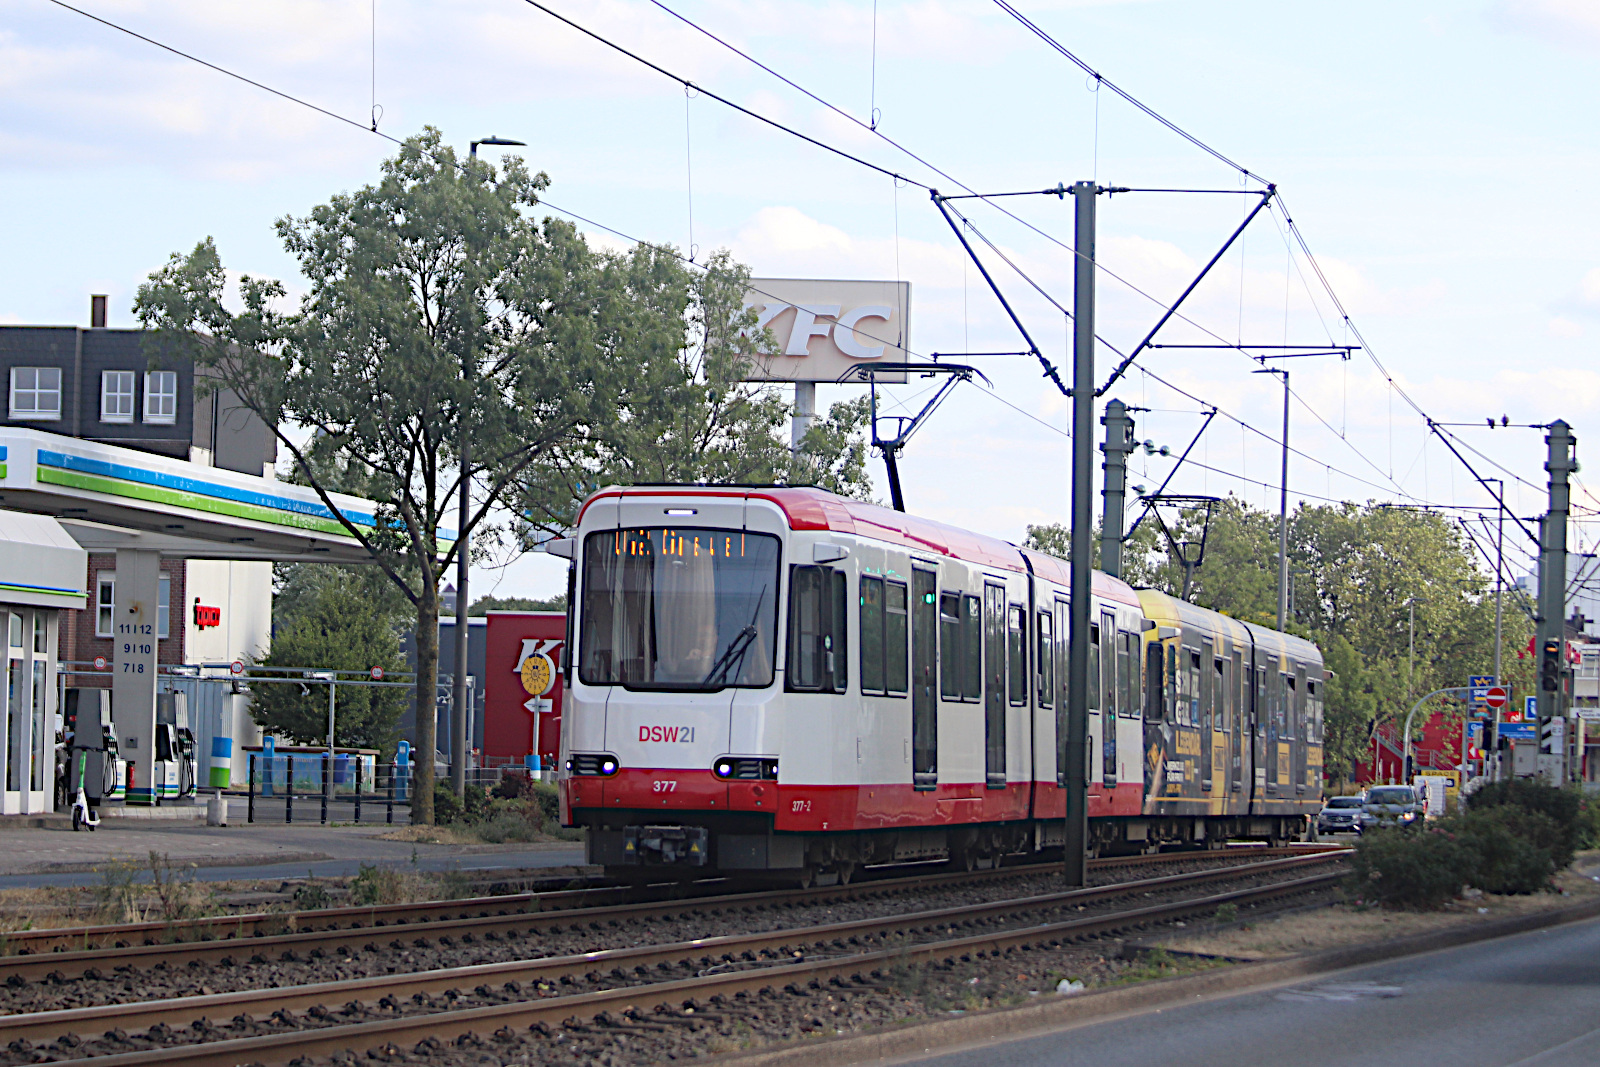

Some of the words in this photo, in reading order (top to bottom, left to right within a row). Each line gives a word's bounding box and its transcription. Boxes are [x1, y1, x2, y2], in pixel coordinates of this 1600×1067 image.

[733, 303, 891, 358] KFC
[119, 624, 130, 634] 11
[139, 624, 152, 635] 12
[124, 643, 130, 653] 9
[139, 644, 151, 654] 10
[123, 663, 129, 673] 7
[137, 663, 144, 673] 8
[653, 780, 677, 792] 377
[792, 800, 811, 812] 377-2
